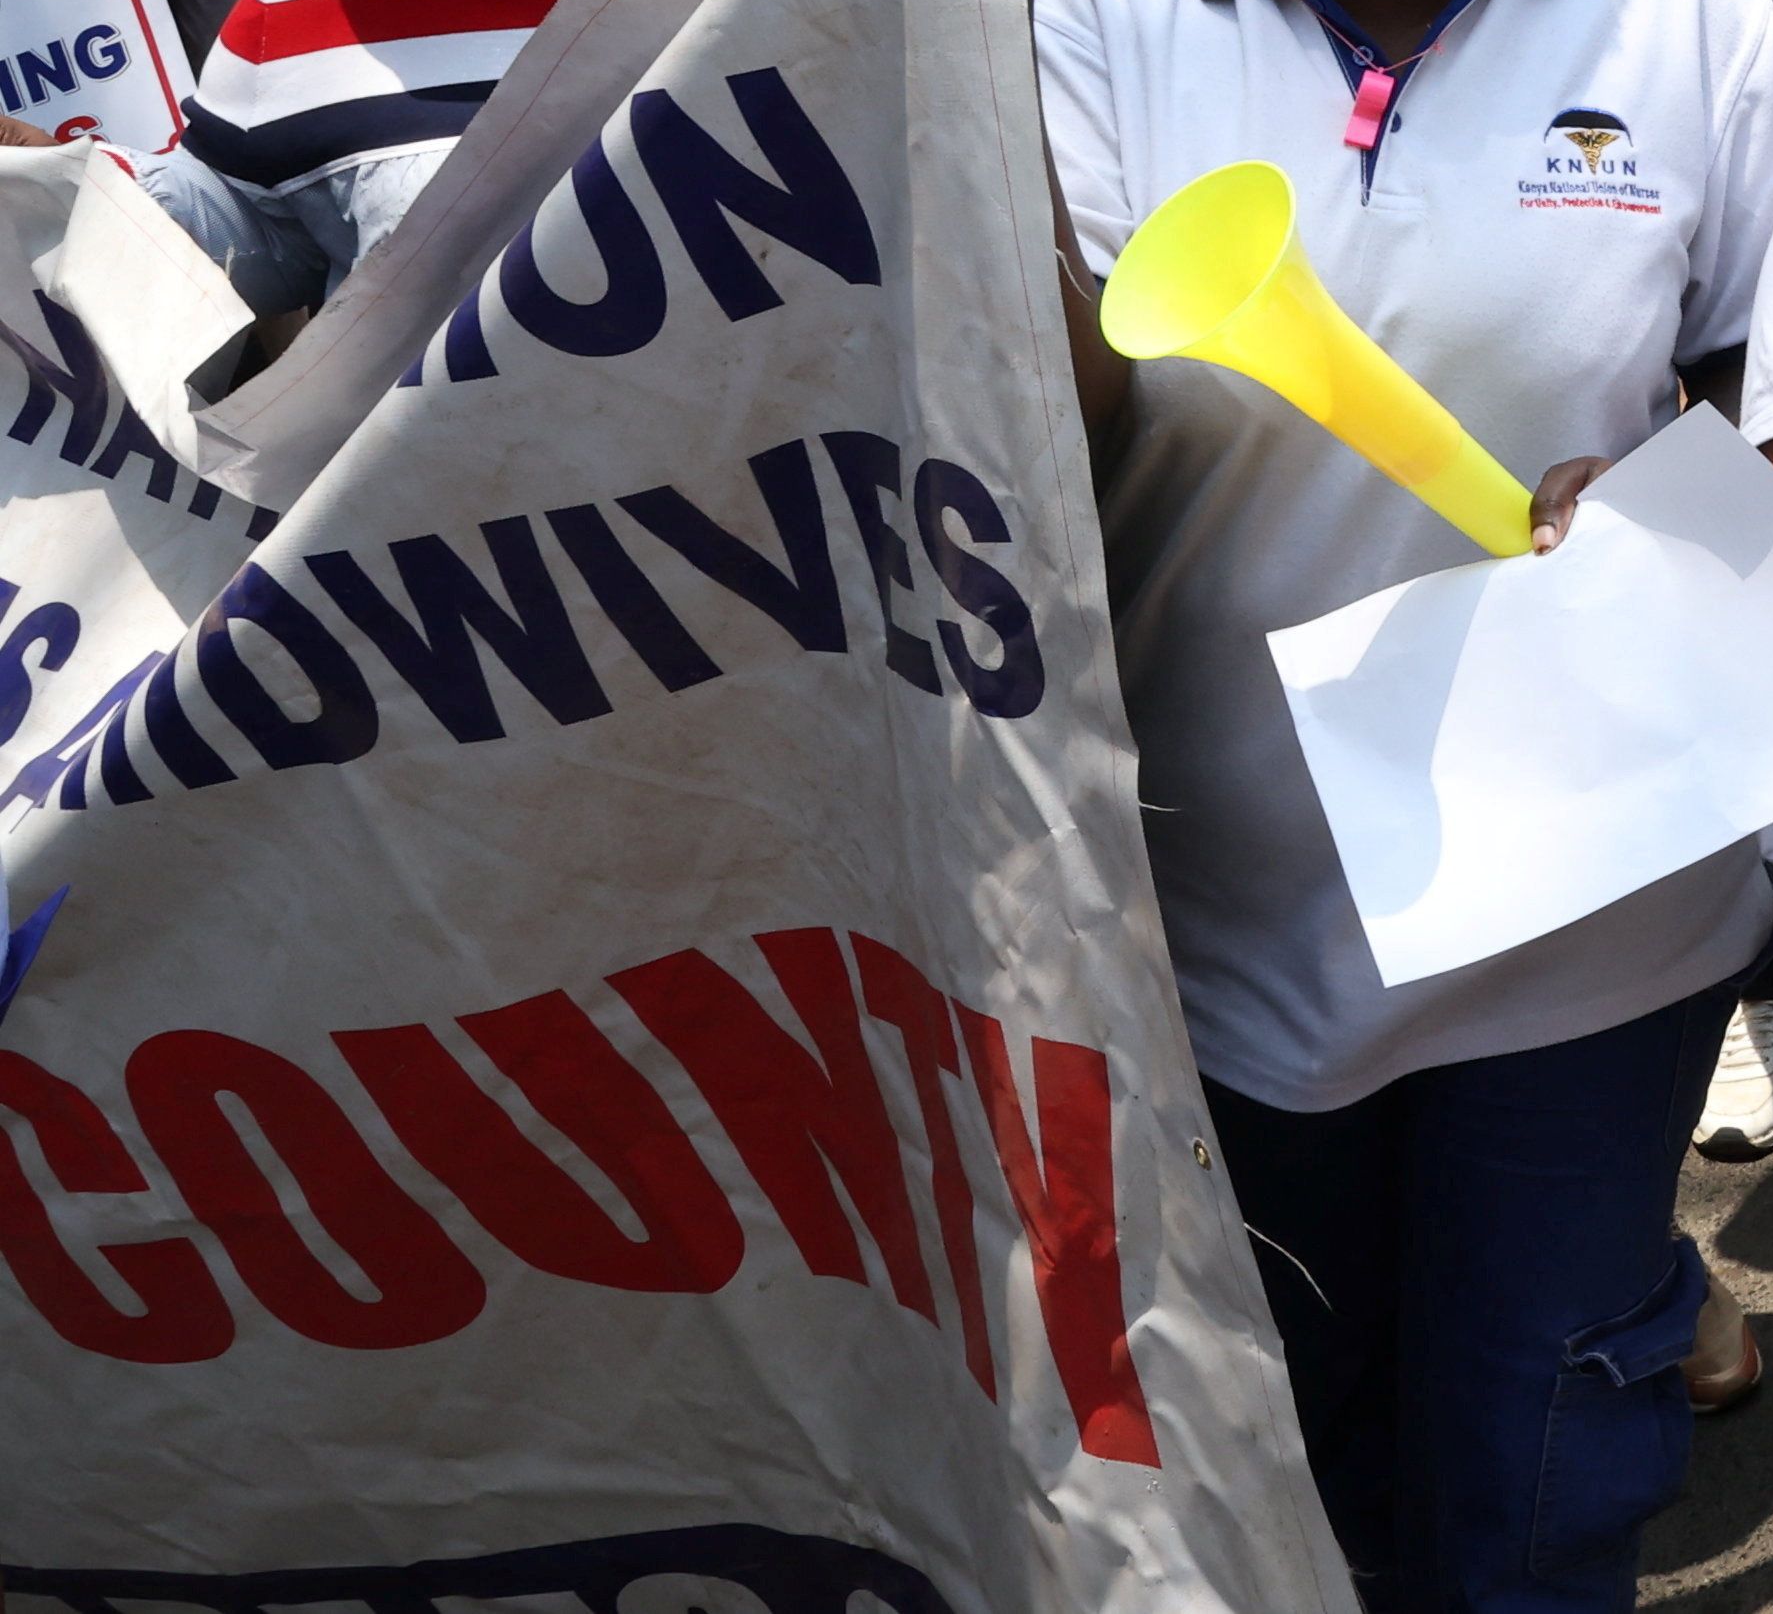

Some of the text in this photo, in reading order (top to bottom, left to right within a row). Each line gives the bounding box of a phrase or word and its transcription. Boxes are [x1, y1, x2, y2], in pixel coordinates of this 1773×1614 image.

[1518, 180, 1549, 196] Kenya
[1550, 181, 1590, 194] National
[1591, 181, 1618, 194] Union
[1619, 183, 1628, 195] of
[1562, 197, 1605, 208] Protection
[0, 927, 1162, 1469] COUNTY
